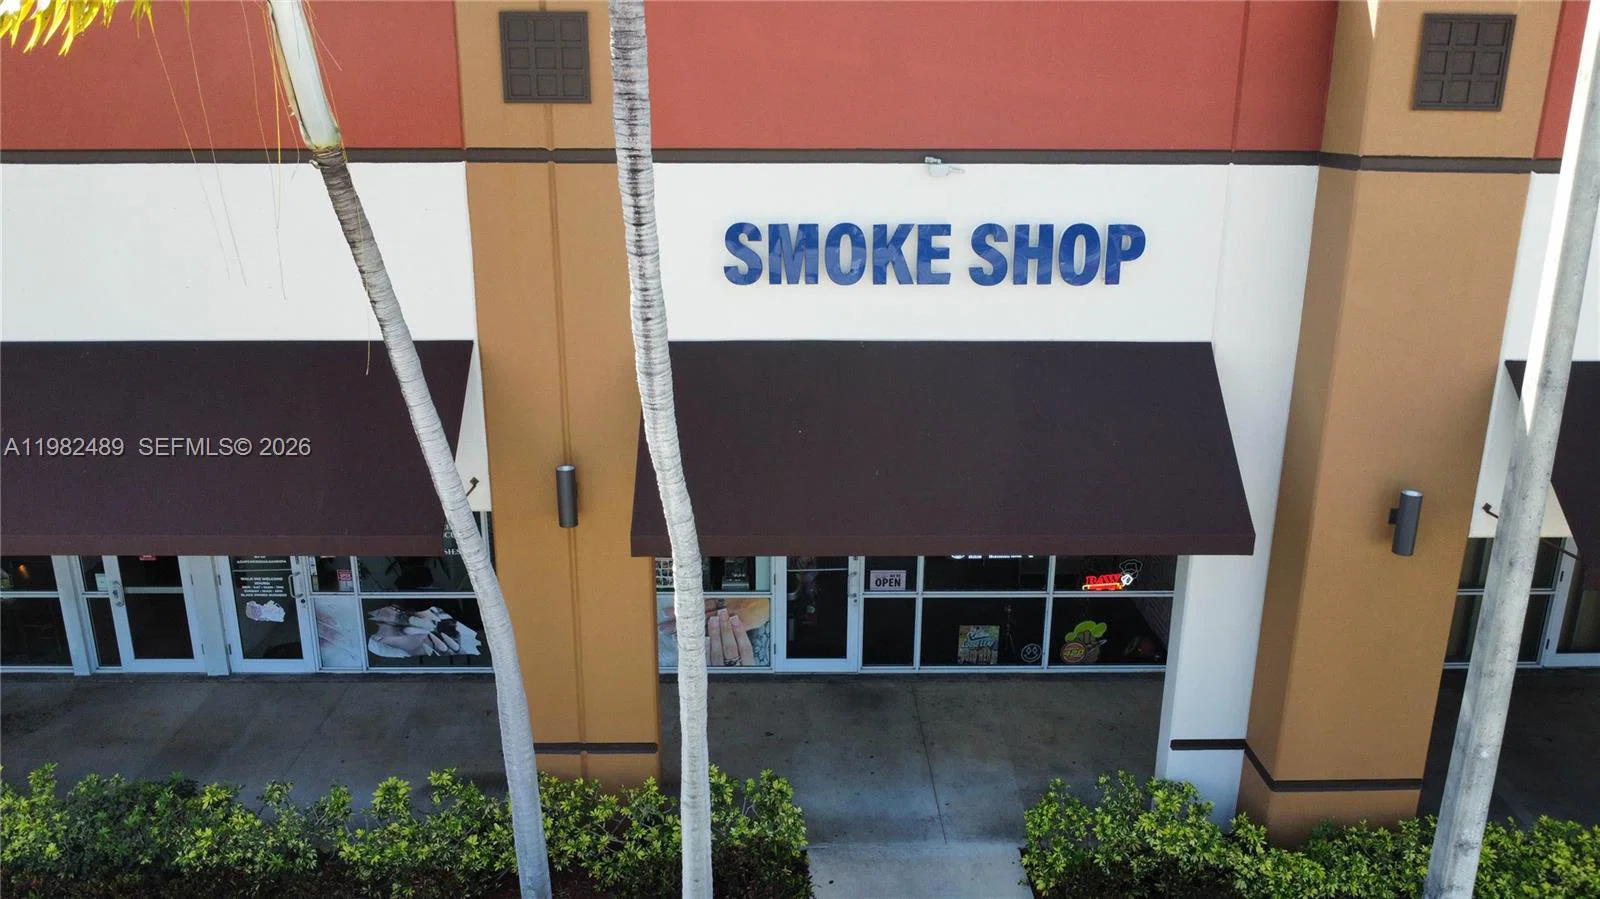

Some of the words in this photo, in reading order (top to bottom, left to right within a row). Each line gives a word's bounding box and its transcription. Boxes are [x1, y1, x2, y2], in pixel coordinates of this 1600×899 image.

[723, 222, 952, 286] SMOKE
[968, 222, 1147, 286] SHOP
[875, 578, 901, 587] OPEN
[1085, 573, 1121, 585] RAW
